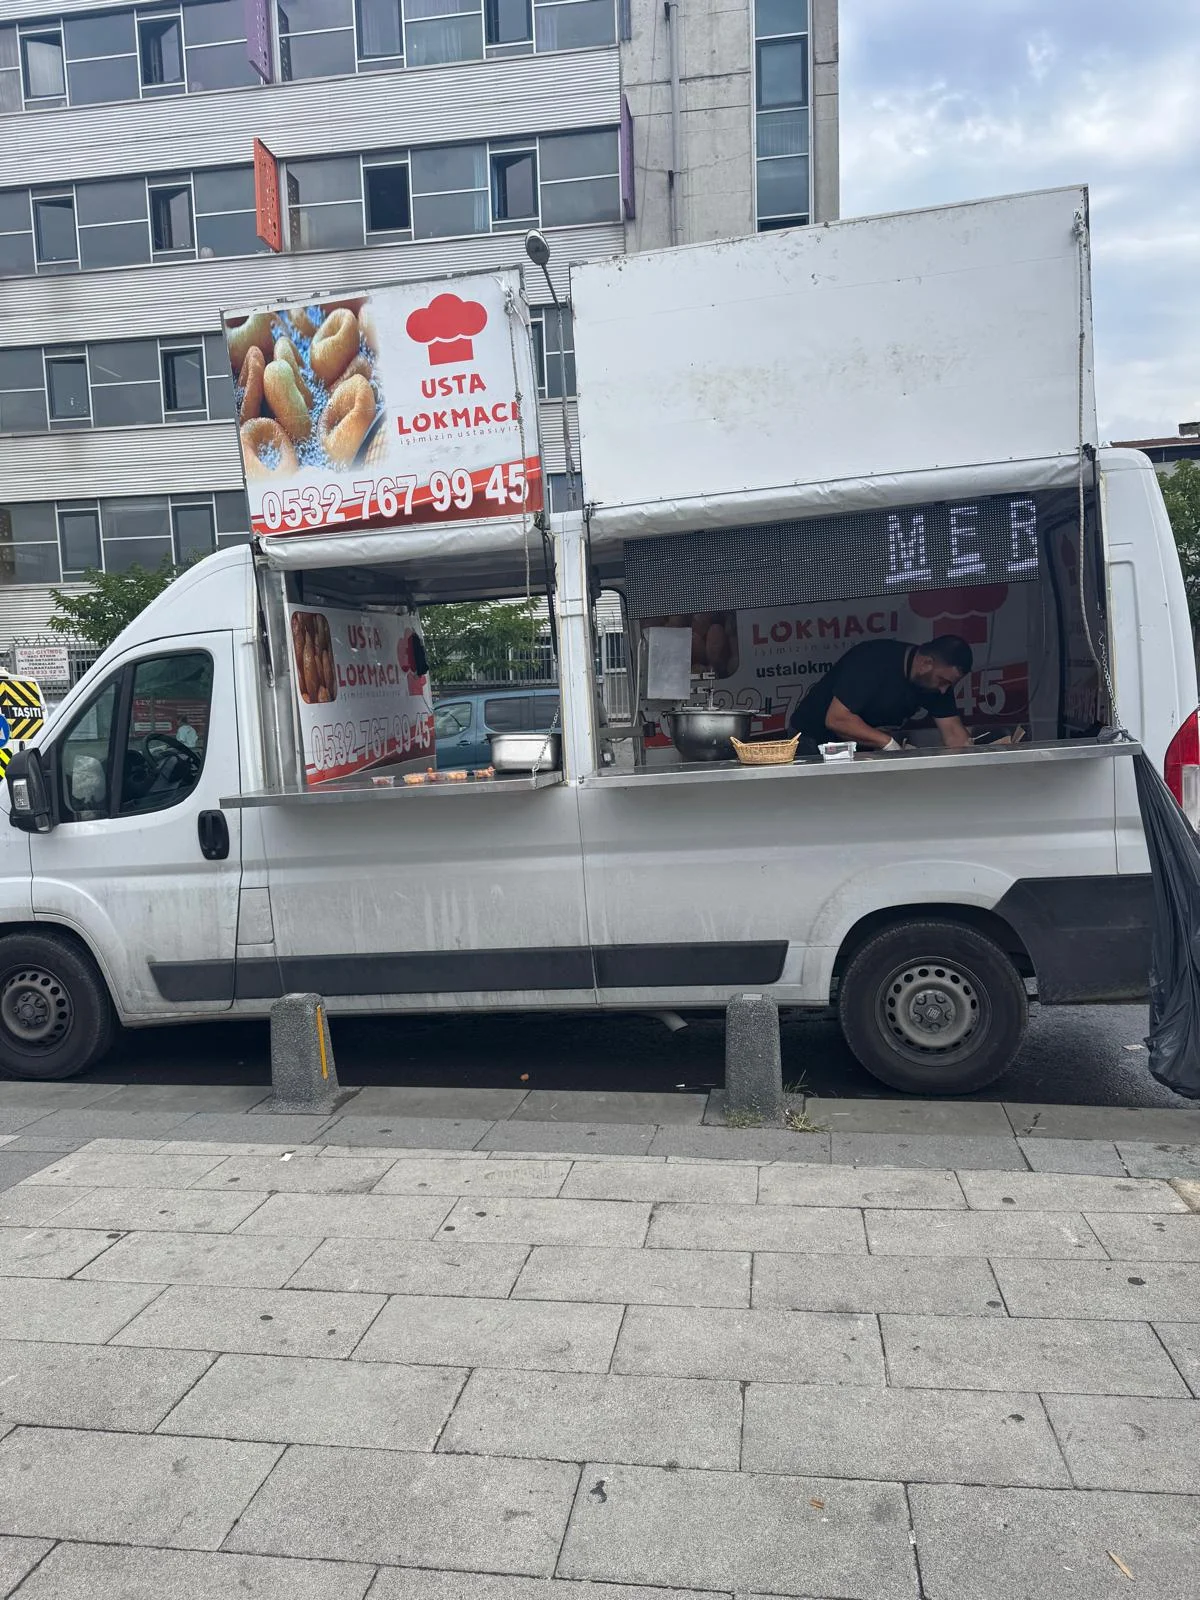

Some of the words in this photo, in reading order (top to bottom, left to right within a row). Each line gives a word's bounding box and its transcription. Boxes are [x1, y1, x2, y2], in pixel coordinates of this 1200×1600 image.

[421, 373, 487, 399] USTA
[397, 401, 520, 436] LOKMACI
[400, 433, 453, 446] işimizin
[261, 484, 347, 530] 0532
[353, 474, 418, 521] 767
[429, 468, 473, 512] 99
[485, 463, 530, 506] 45
[347, 625, 383, 650] USTA
[752, 611, 899, 645] LOKMACI
[336, 662, 400, 688] LOKMACI
[953, 668, 1006, 716] 45
[11, 706, 42, 719] TAŞITI
[311, 720, 358, 771] 0532
[360, 716, 389, 761] 767
[394, 713, 412, 755] 99
[414, 711, 431, 749] 45
